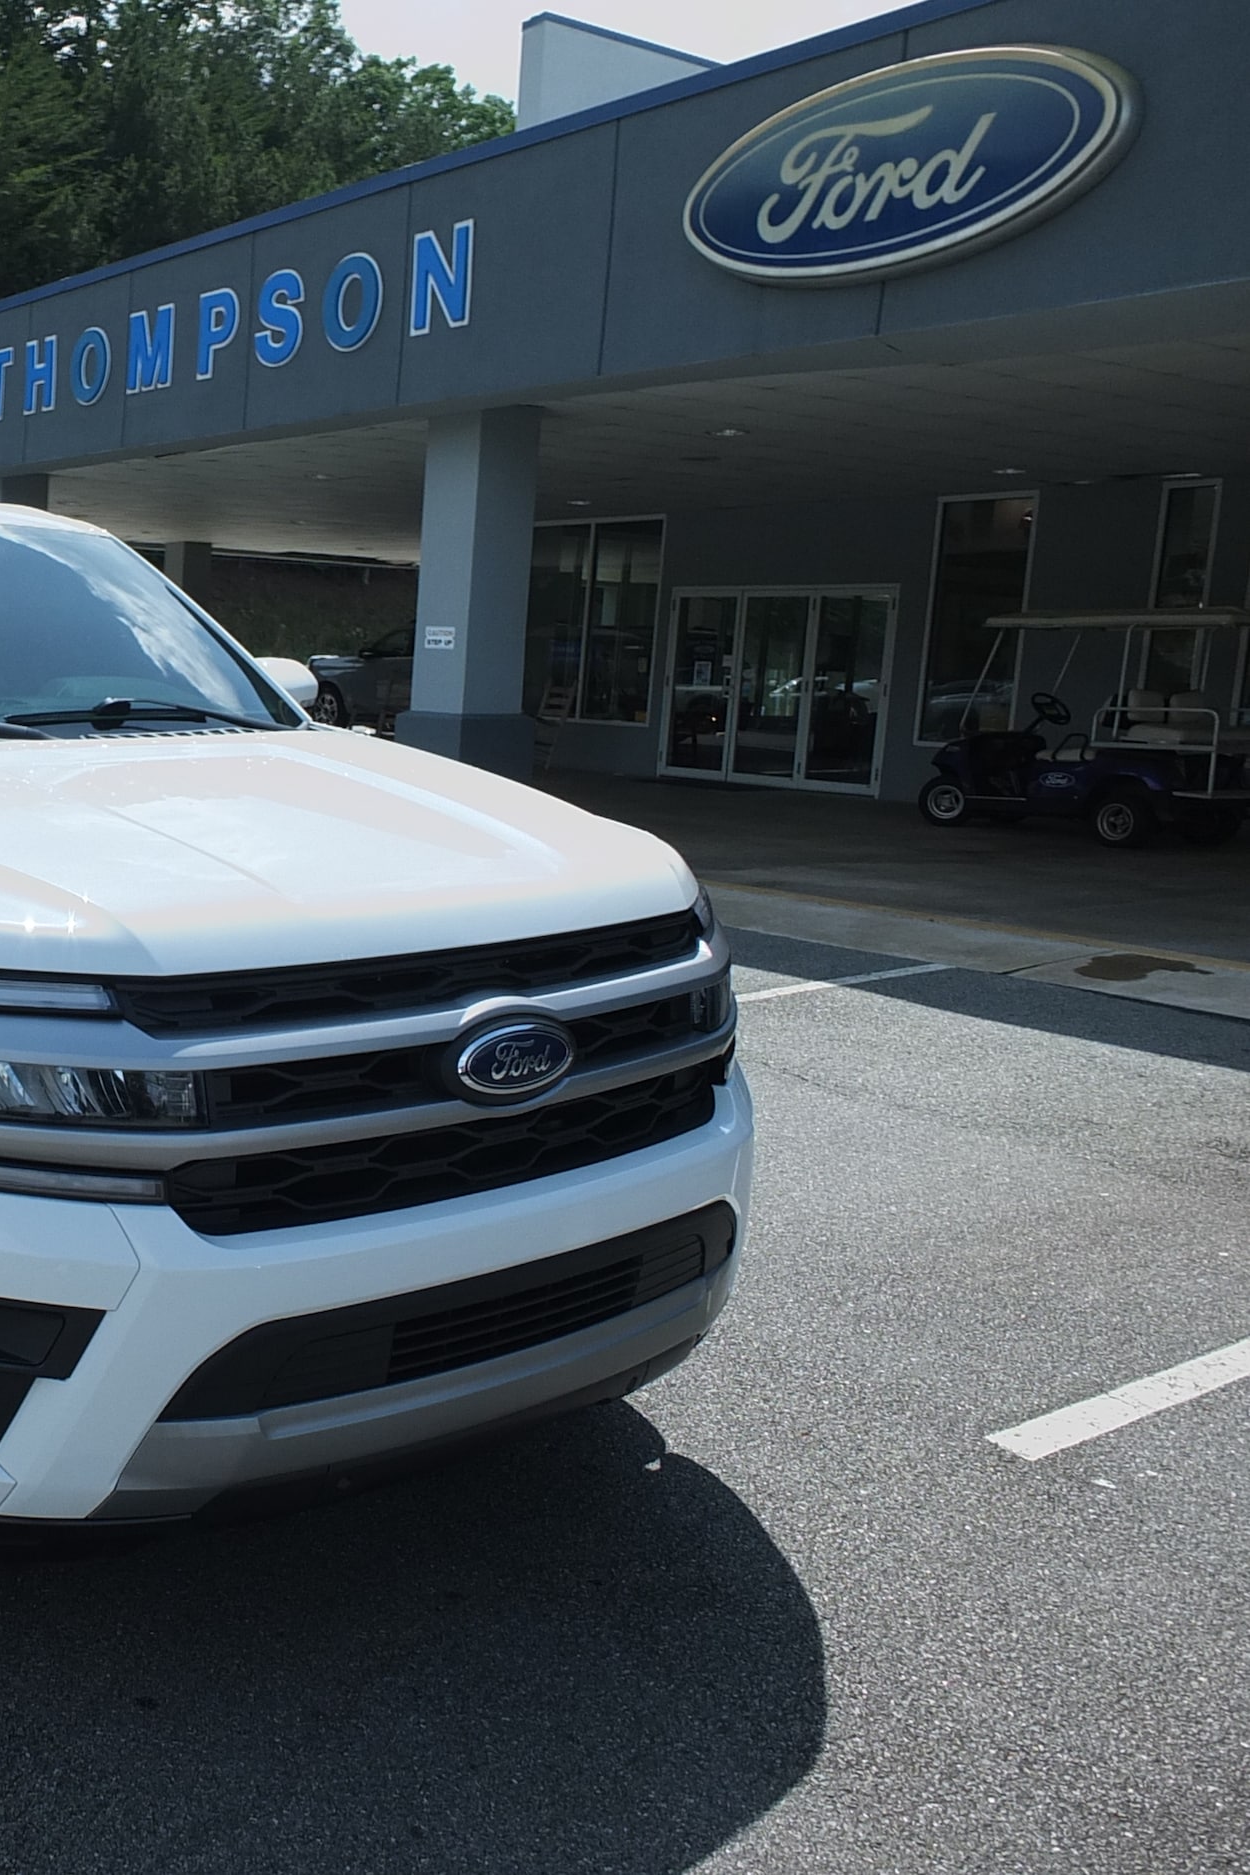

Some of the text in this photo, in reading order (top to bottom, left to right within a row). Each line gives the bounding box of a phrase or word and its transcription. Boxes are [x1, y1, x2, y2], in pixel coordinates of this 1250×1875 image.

[756, 104, 997, 244] Ford
[426, 638, 453, 647] STEP UP
[1045, 773, 1068, 785] Ford
[490, 1038, 551, 1081] Ford
